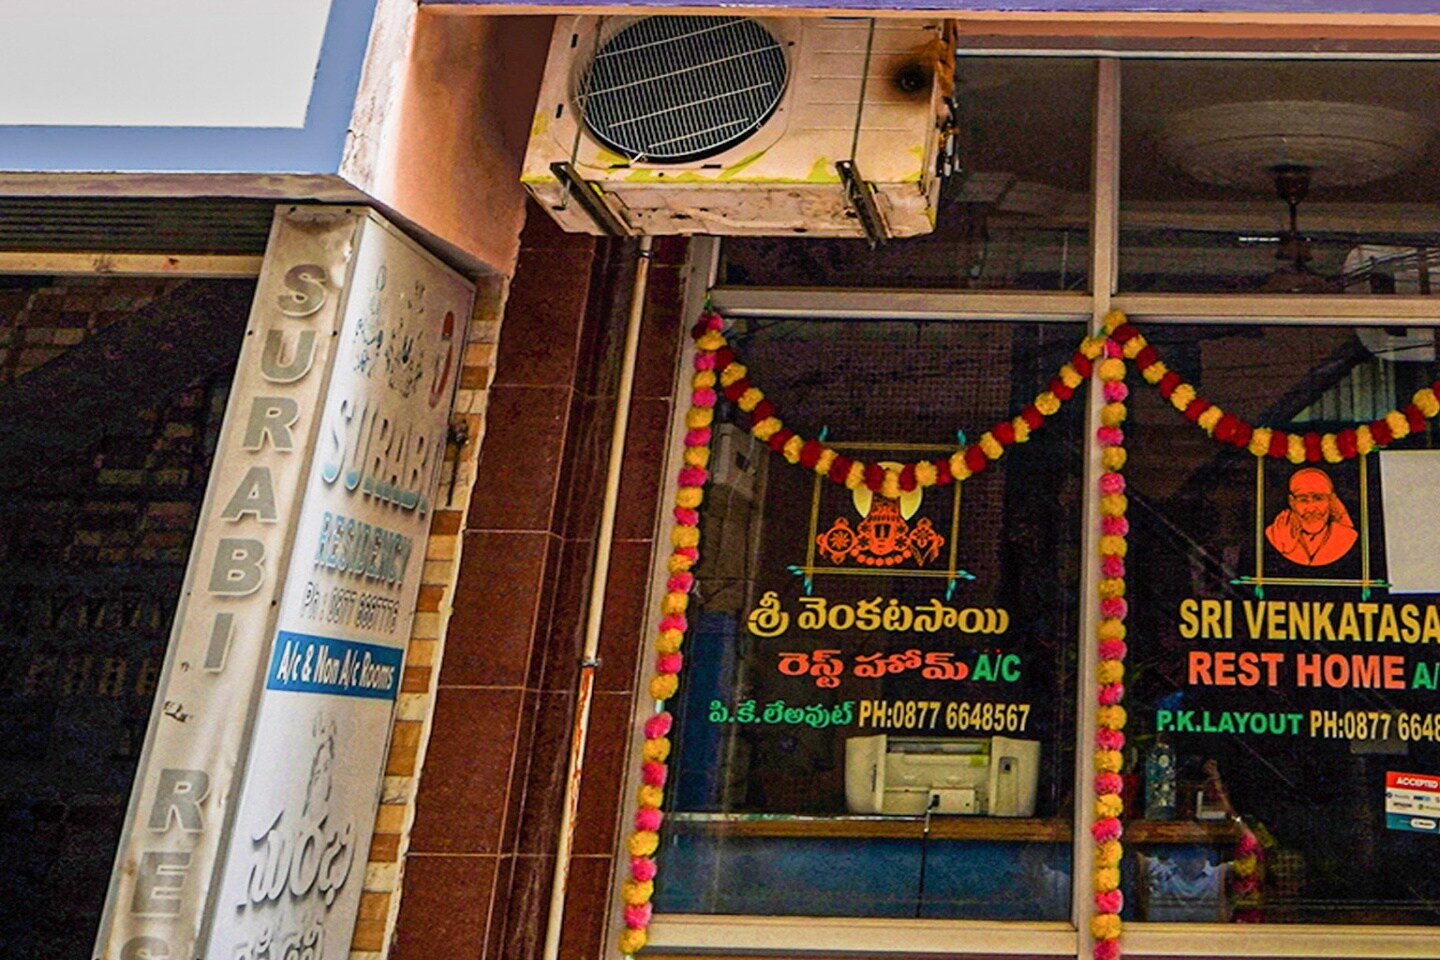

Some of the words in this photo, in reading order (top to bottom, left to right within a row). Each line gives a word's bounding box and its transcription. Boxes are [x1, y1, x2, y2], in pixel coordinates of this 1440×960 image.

[203, 263, 327, 674] SURABI
[314, 511, 412, 585] RESIDENCY
[748, 591, 789, 637] శ్రీ
[799, 596, 1010, 635] వెంకటసాయి
[1179, 598, 1233, 639] SRI
[301, 643, 315, 683] &
[313, 644, 340, 685] Non
[359, 651, 395, 690] Rooms
[778, 649, 844, 688] రెస్ట్
[971, 653, 1022, 682] A/C
[1188, 651, 1284, 687] REST
[1296, 653, 1406, 690] HOME
[858, 700, 940, 729] PH:0877
[945, 702, 1031, 732] 6648567
[1157, 709, 1304, 735] P.K.LAYOUT
[1310, 712, 1391, 740] PH:0877
[1396, 777, 1438, 789] ACCEPTED
